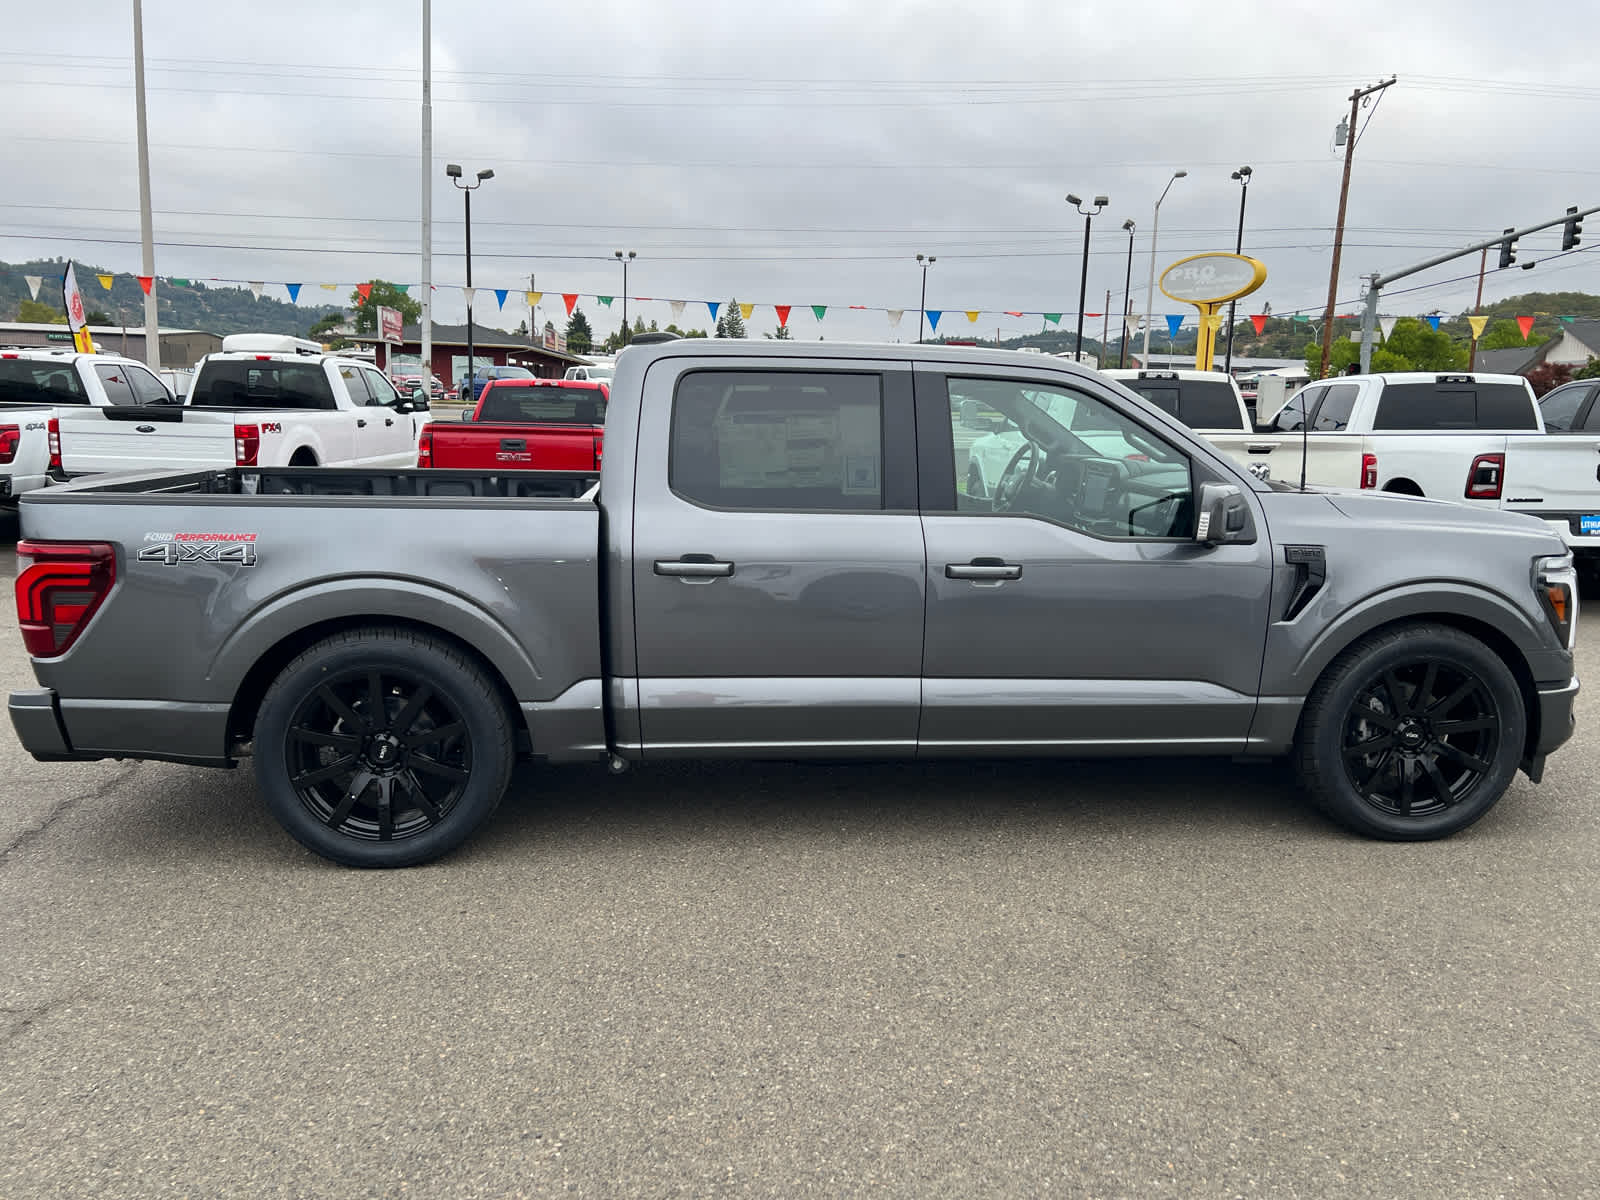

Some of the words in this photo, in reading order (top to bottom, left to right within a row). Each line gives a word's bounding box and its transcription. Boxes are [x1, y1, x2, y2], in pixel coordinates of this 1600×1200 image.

[260, 422, 282, 434] FX4
[495, 452, 532, 461] GMC
[144, 532, 173, 541] FORD
[174, 532, 257, 542] PERFORMANCE
